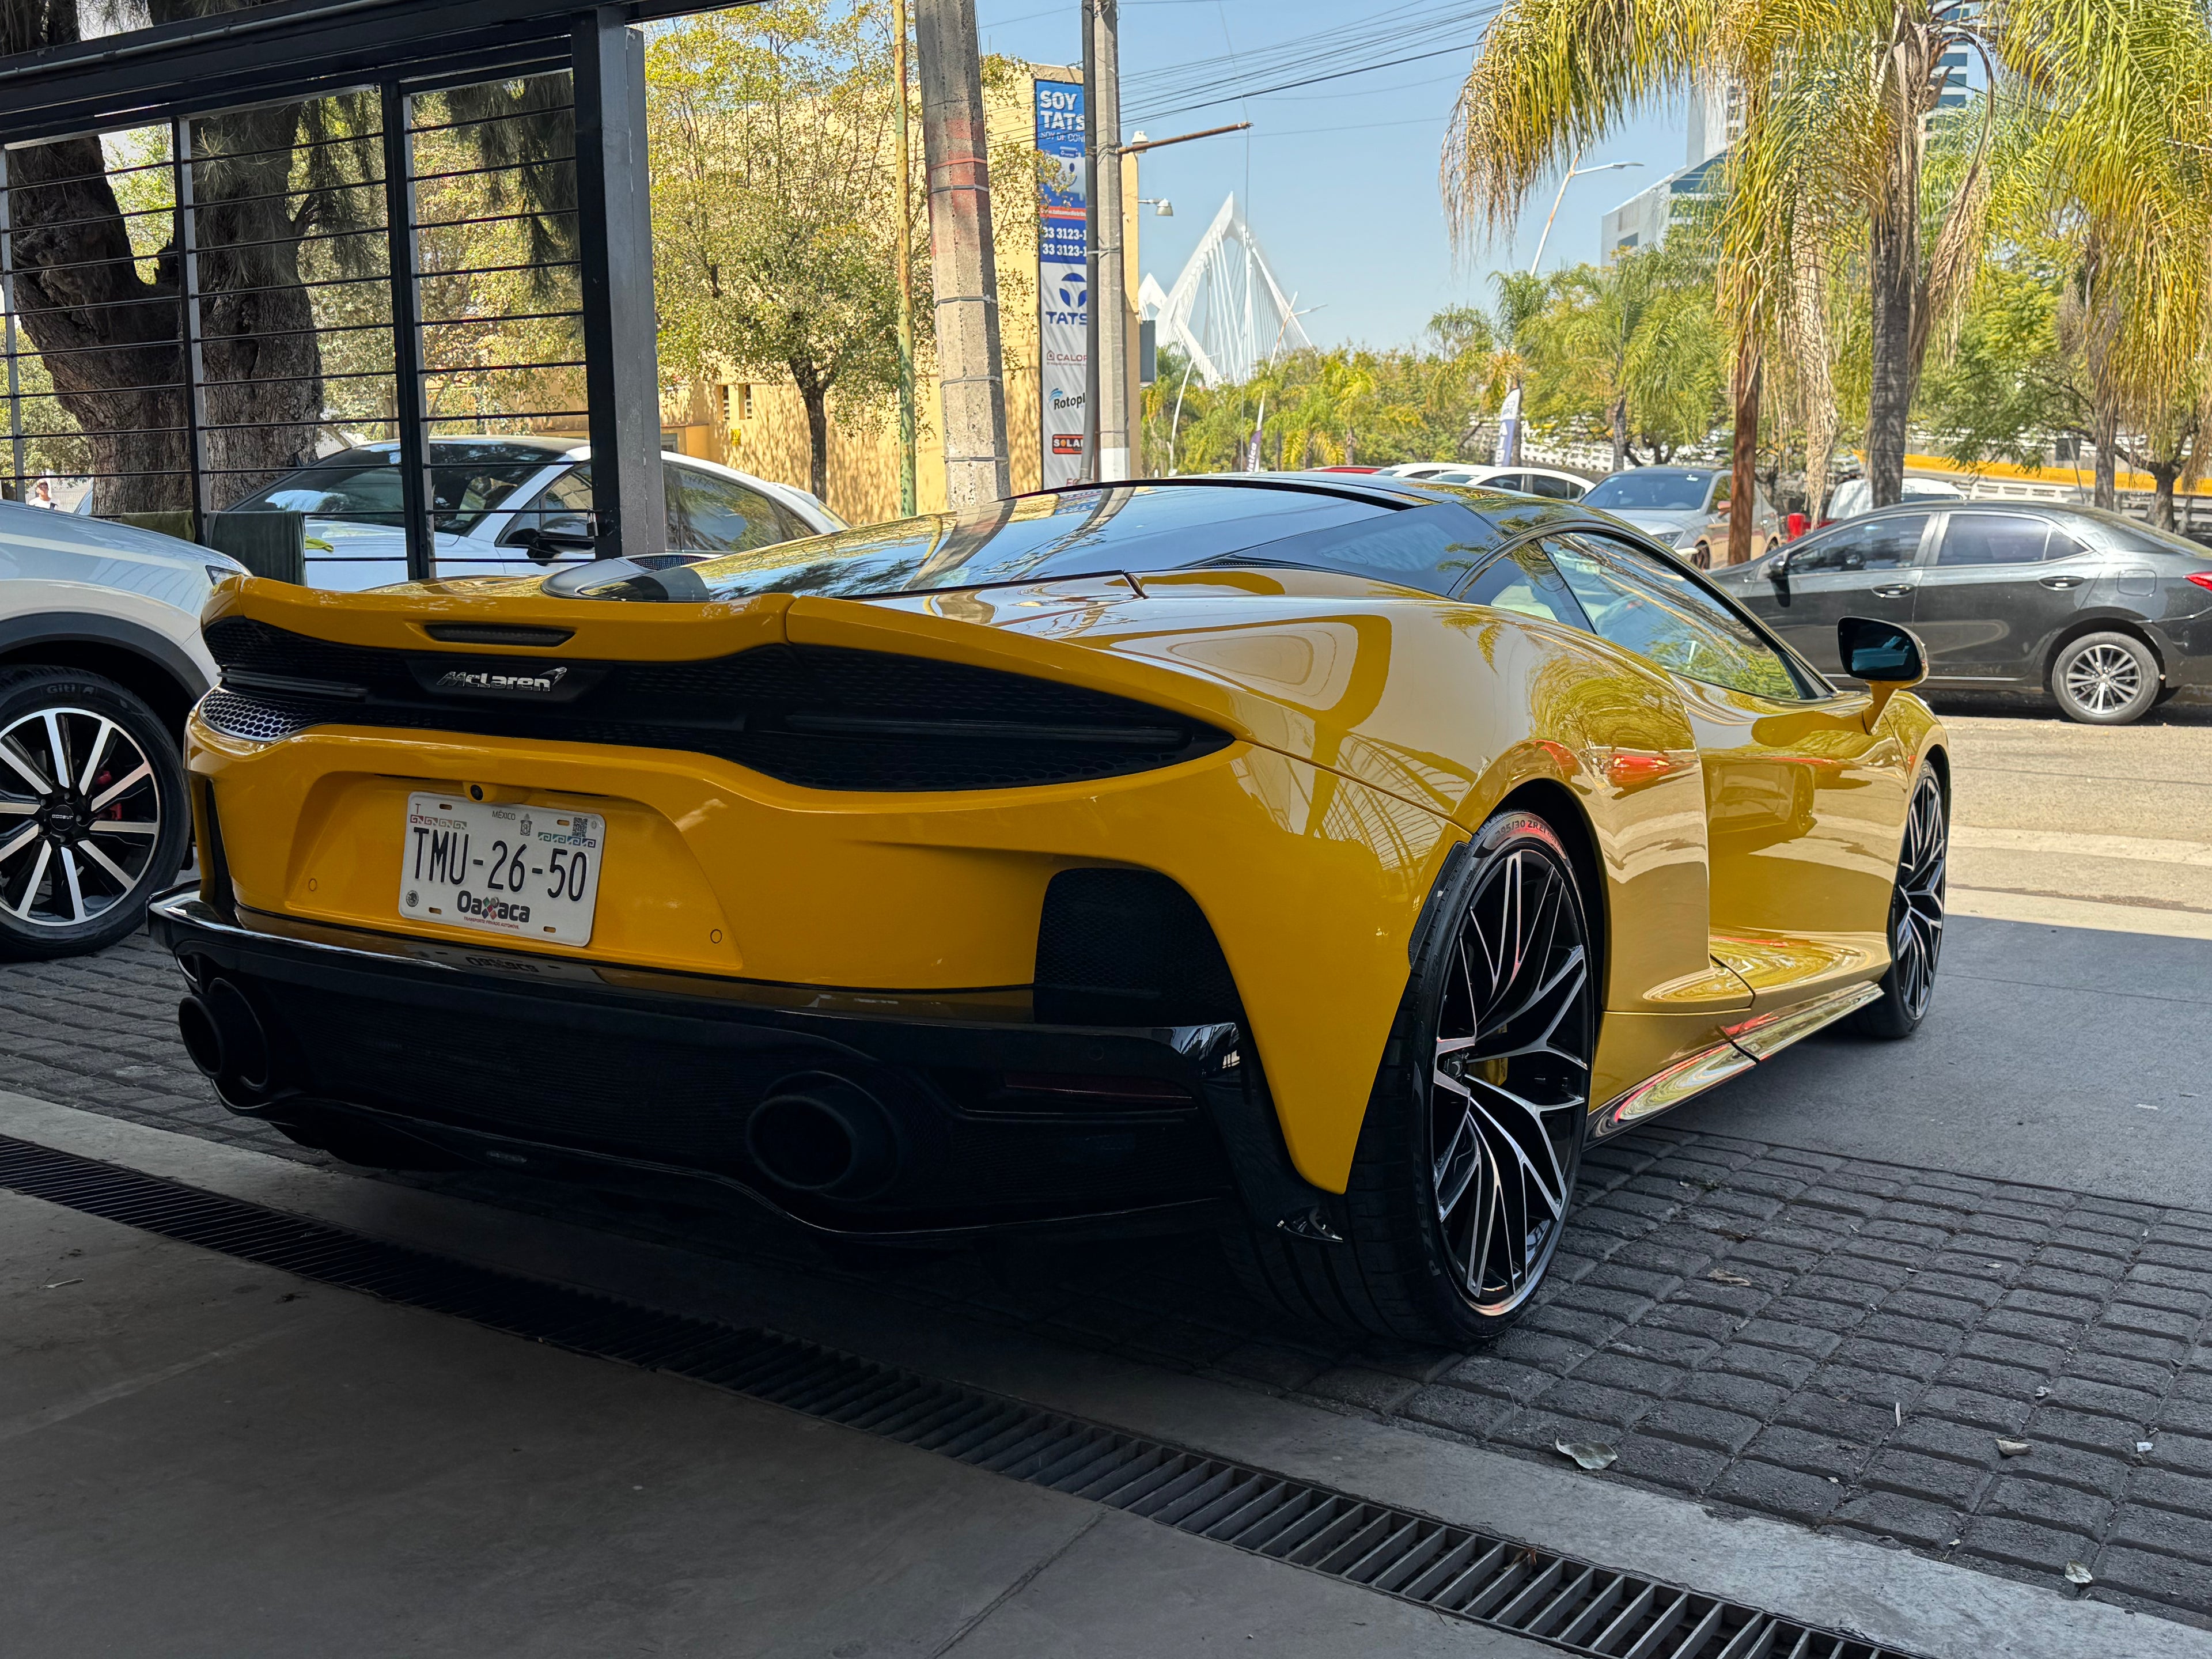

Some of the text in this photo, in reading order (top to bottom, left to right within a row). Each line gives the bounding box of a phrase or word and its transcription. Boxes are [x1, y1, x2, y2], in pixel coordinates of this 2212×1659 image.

[1040, 90, 1077, 111] SOY
[1040, 111, 1085, 131] TATS
[1042, 226, 1086, 240] 33 3123-1
[1042, 243, 1086, 257] 33 3123-1
[1046, 312, 1088, 325] TATS
[1054, 392, 1085, 410] Rotopl
[46, 684, 75, 694] Giti
[436, 671, 551, 692] McLaren
[492, 809, 516, 820] MÉXICO
[413, 827, 587, 902] TMU-26-50
[457, 890, 531, 923] Oaxaca
